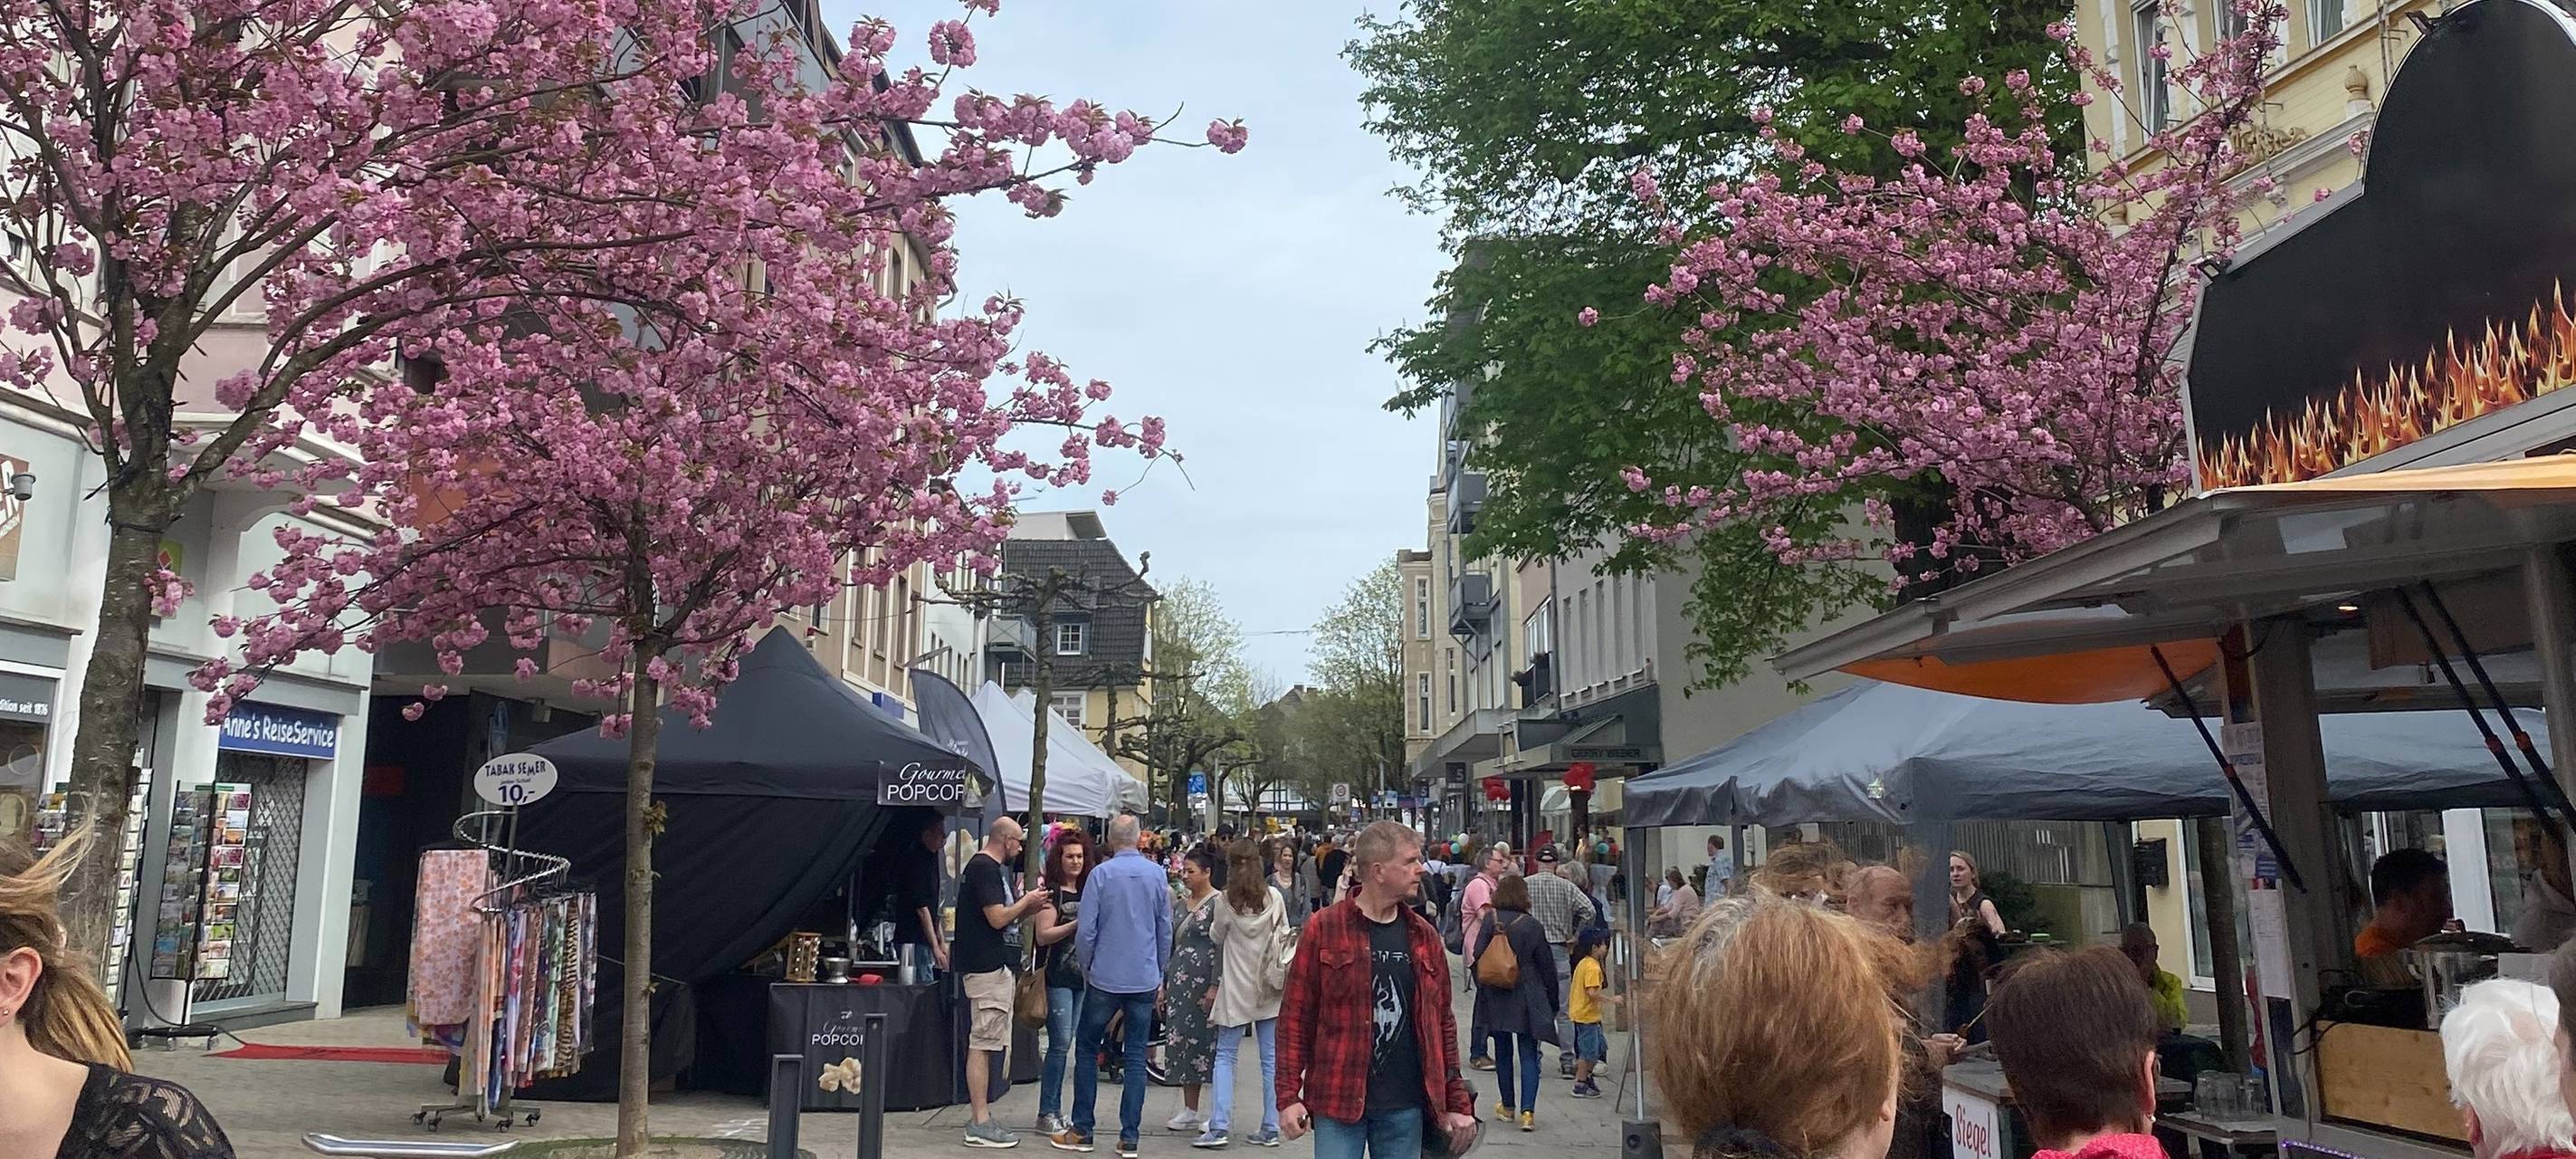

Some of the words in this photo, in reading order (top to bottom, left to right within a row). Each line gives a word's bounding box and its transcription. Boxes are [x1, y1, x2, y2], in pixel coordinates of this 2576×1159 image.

[224, 711, 261, 740] Anne's
[262, 714, 335, 748] ReiseService
[485, 762, 515, 778] TABAK
[518, 761, 546, 777] SEMER
[899, 761, 965, 788] Gourme
[498, 784, 535, 803] 10,-
[811, 1033, 864, 1046] POPCO
[1956, 1104, 1991, 1159] Siegel
